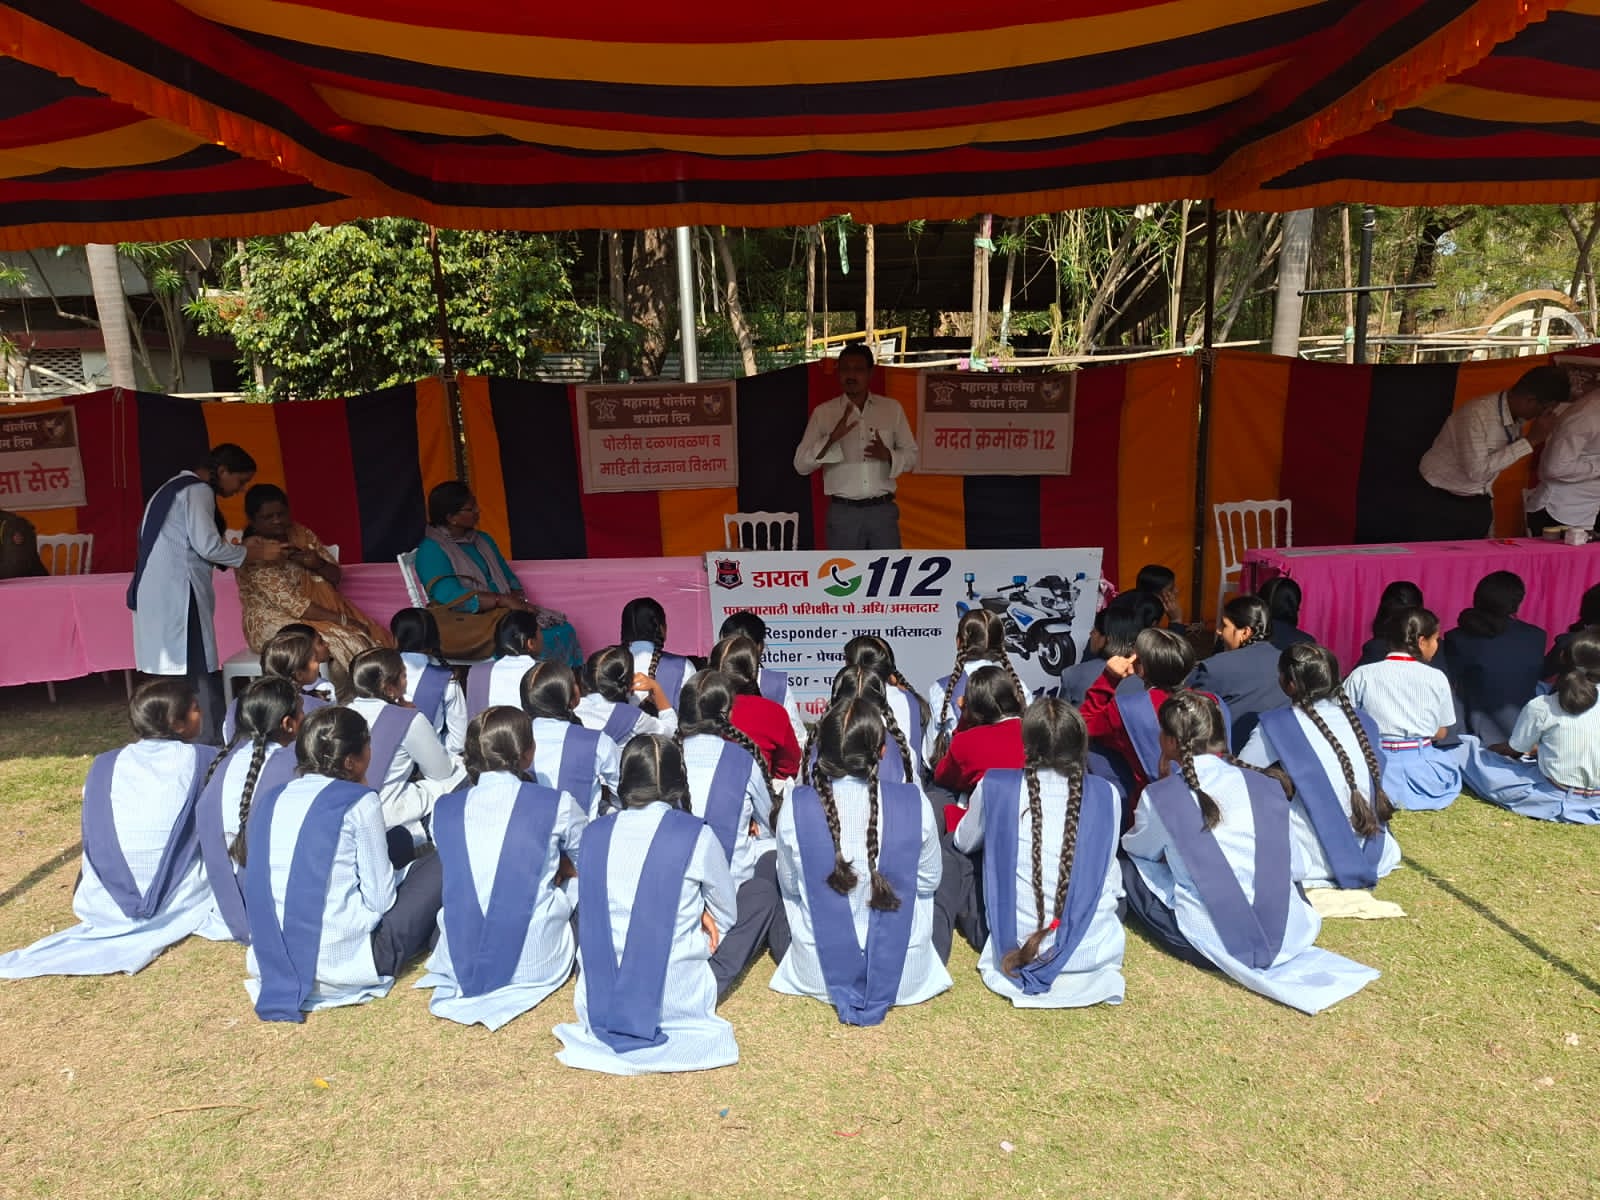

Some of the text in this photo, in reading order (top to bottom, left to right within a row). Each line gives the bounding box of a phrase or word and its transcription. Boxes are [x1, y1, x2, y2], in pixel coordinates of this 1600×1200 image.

[1001, 378, 1035, 393] पोलीस
[1008, 396, 1028, 411] दिन
[602, 434, 643, 451] पोलीस
[711, 434, 721, 448] व
[934, 421, 1056, 450] मदत क्रमांक 112
[600, 457, 641, 477] माहिती
[689, 455, 727, 472] विभाग
[24, 461, 70, 492] सेल
[751, 556, 952, 597] डायल 112
[765, 626, 837, 642] Responder
[760, 650, 802, 662] atcher
[788, 676, 809, 687] sor
